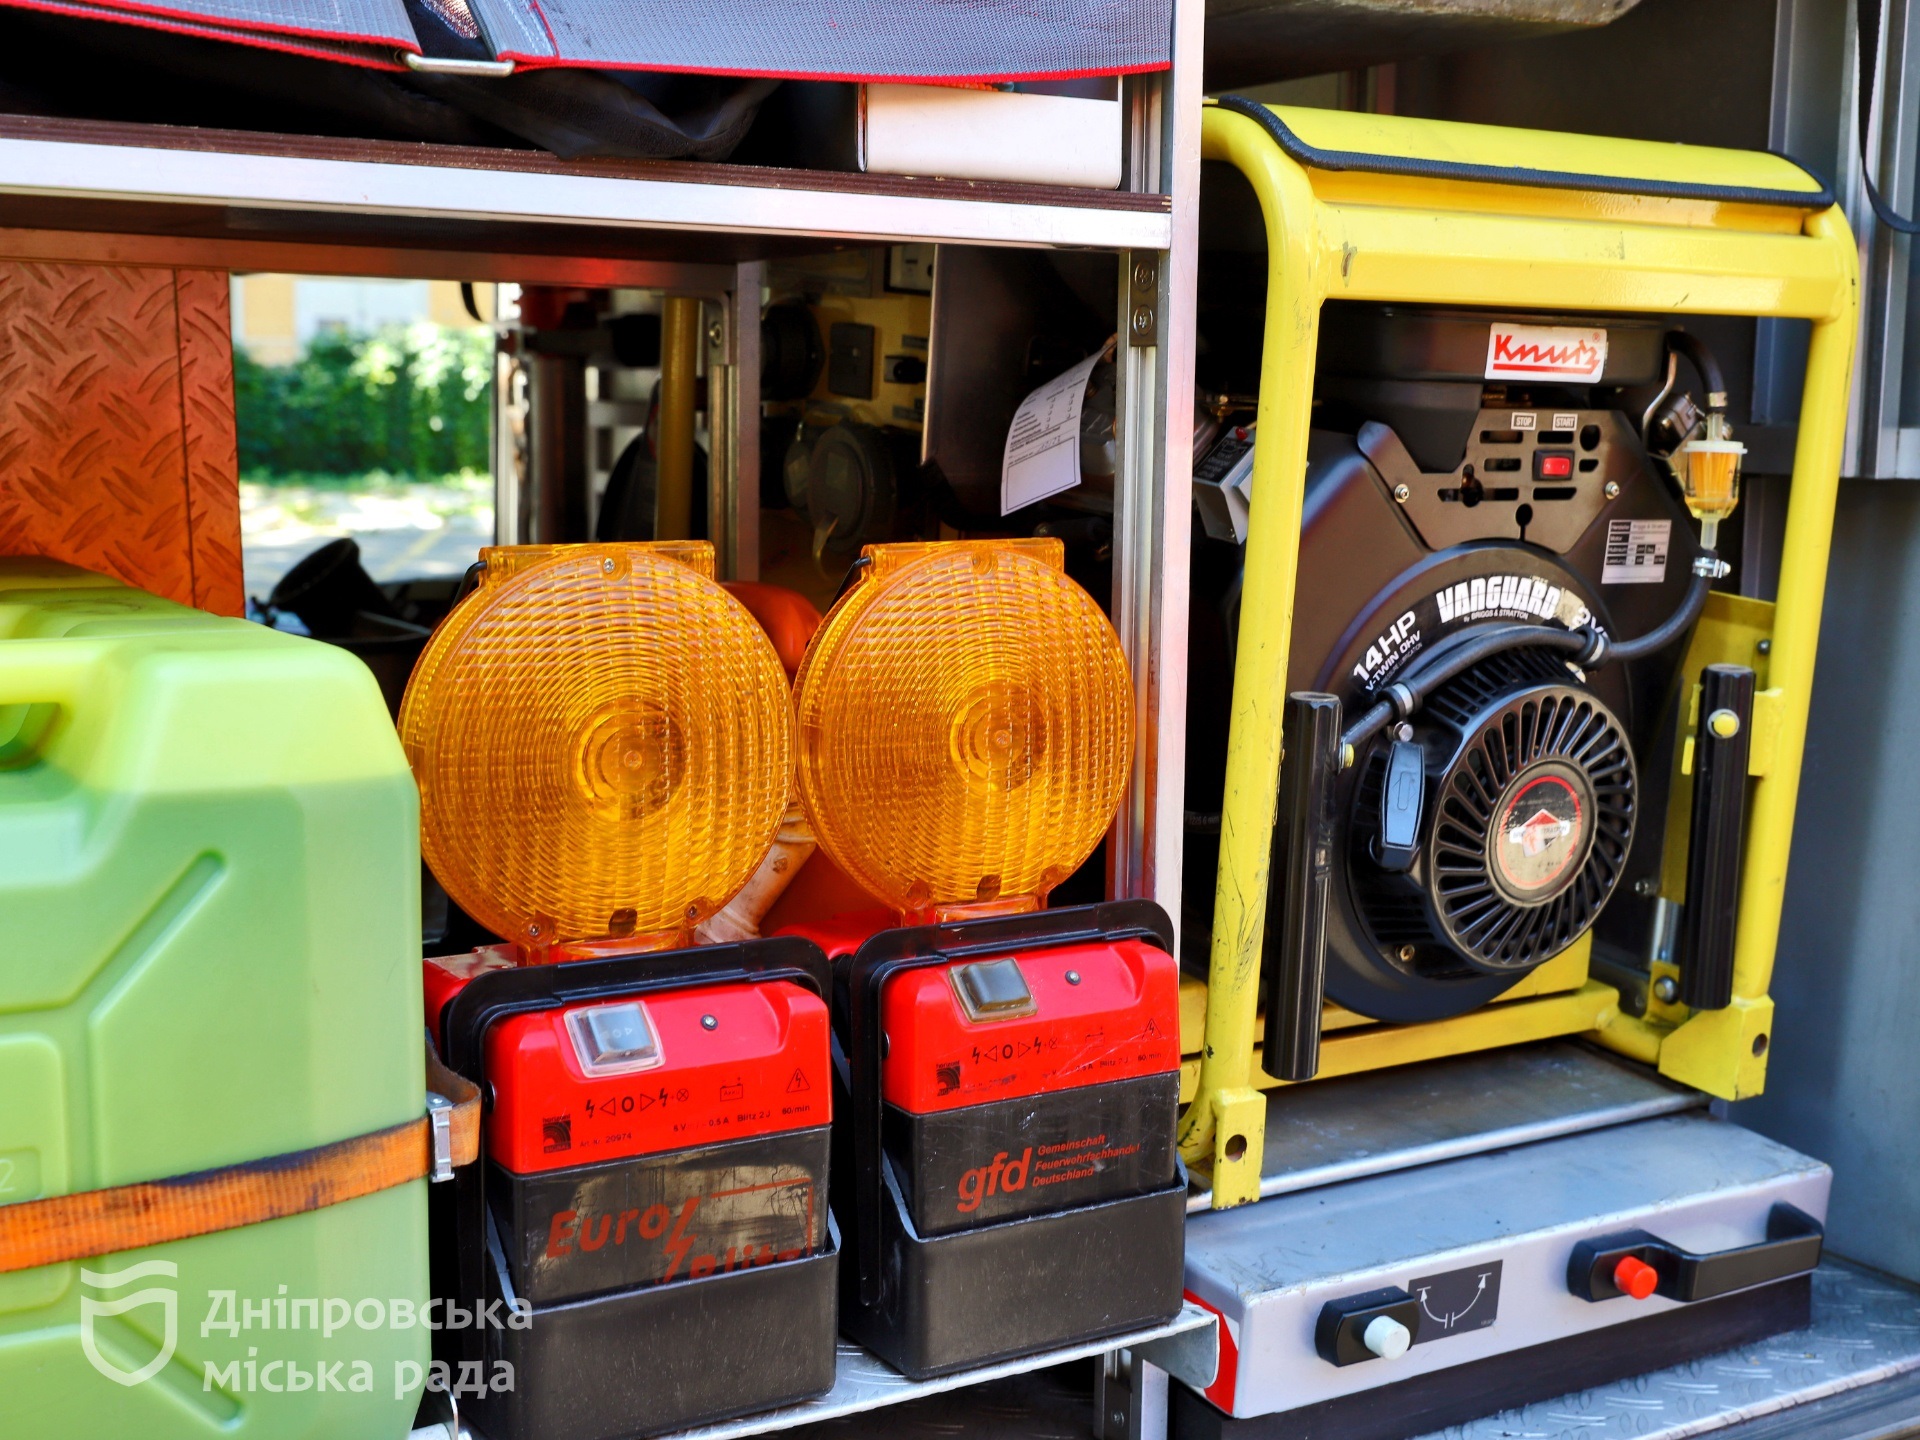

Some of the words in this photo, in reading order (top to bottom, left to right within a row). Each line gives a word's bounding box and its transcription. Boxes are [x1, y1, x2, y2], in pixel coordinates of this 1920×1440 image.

[1516, 417, 1532, 426] STOP
[1555, 416, 1575, 427] START
[1436, 575, 1561, 624] VANGUARD
[1471, 609, 1494, 621] BRIGGS
[1499, 609, 1529, 621] STRATTON
[1353, 610, 1416, 681] 14HP
[1365, 650, 1400, 691] V-TWIN
[1399, 630, 1421, 654] OHV
[722, 1117, 729, 1125] A
[737, 1113, 756, 1123] Blitz
[782, 1104, 810, 1115] 60/min
[1037, 1134, 1106, 1156] Gemeinschaft
[957, 1147, 1032, 1213] gfd
[1032, 1165, 1094, 1188] Deutschland
[546, 1203, 670, 1259] Euro
